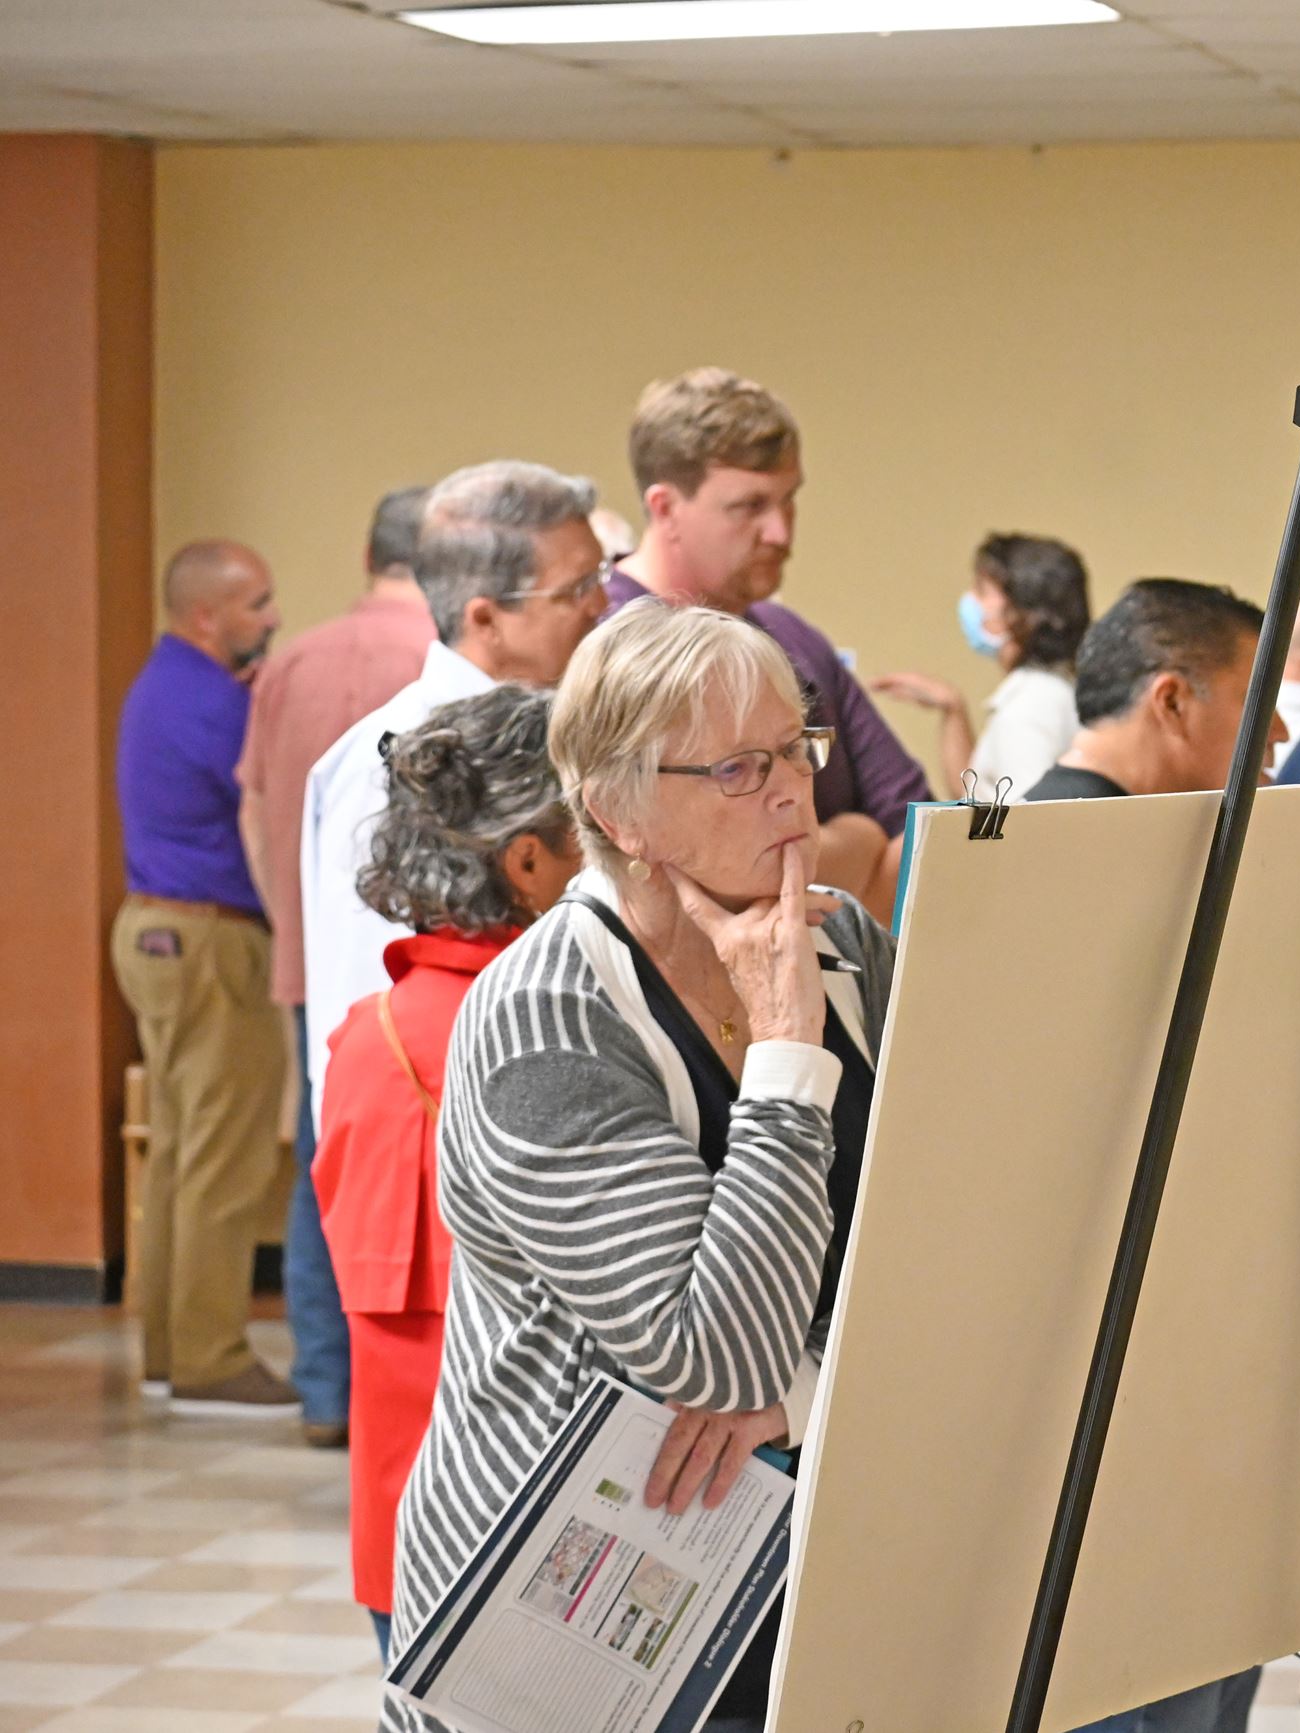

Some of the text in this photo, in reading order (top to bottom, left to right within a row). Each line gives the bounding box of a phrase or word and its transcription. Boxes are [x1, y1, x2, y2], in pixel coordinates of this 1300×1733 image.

[759, 1527, 788, 1569] Downtown
[749, 1566, 767, 1587] Plan
[725, 1583, 756, 1630] Stakeholder
[706, 1626, 732, 1663] Dialogue
